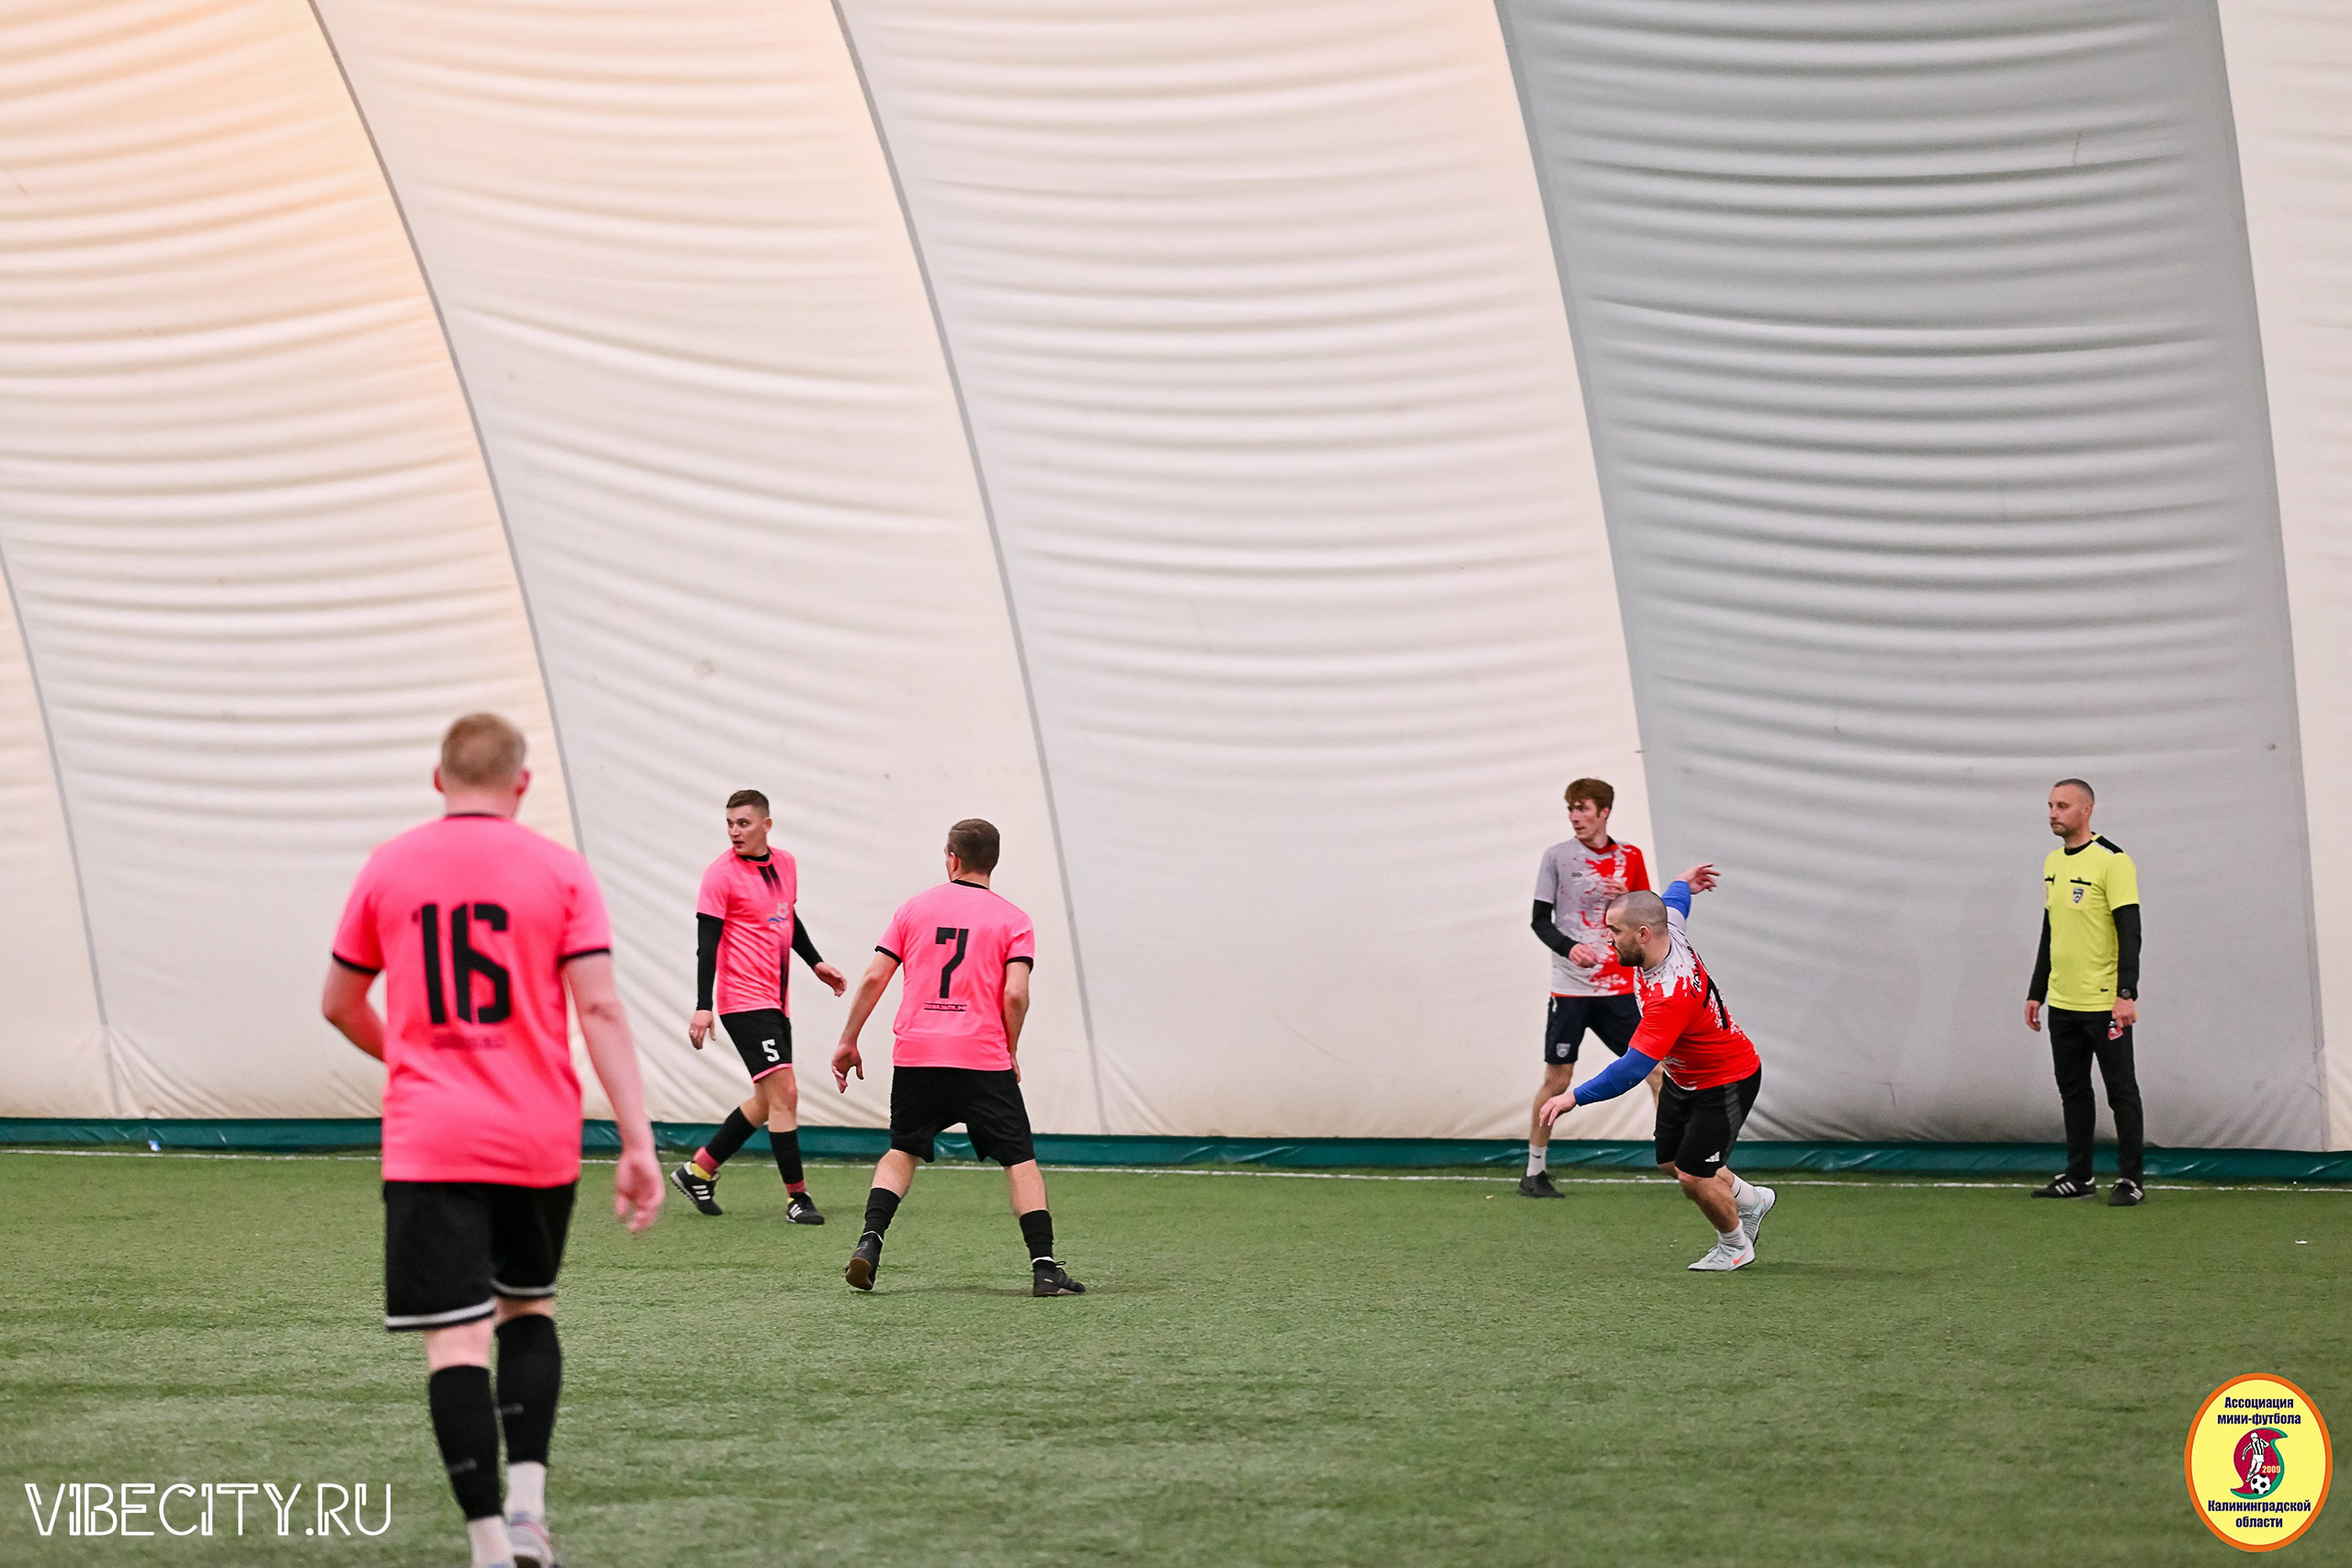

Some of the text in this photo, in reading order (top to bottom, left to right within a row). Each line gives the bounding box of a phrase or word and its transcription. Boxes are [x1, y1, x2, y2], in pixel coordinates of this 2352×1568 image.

[412, 902, 511, 1024] 16
[935, 927, 969, 998] 7
[762, 1039, 780, 1063] 5
